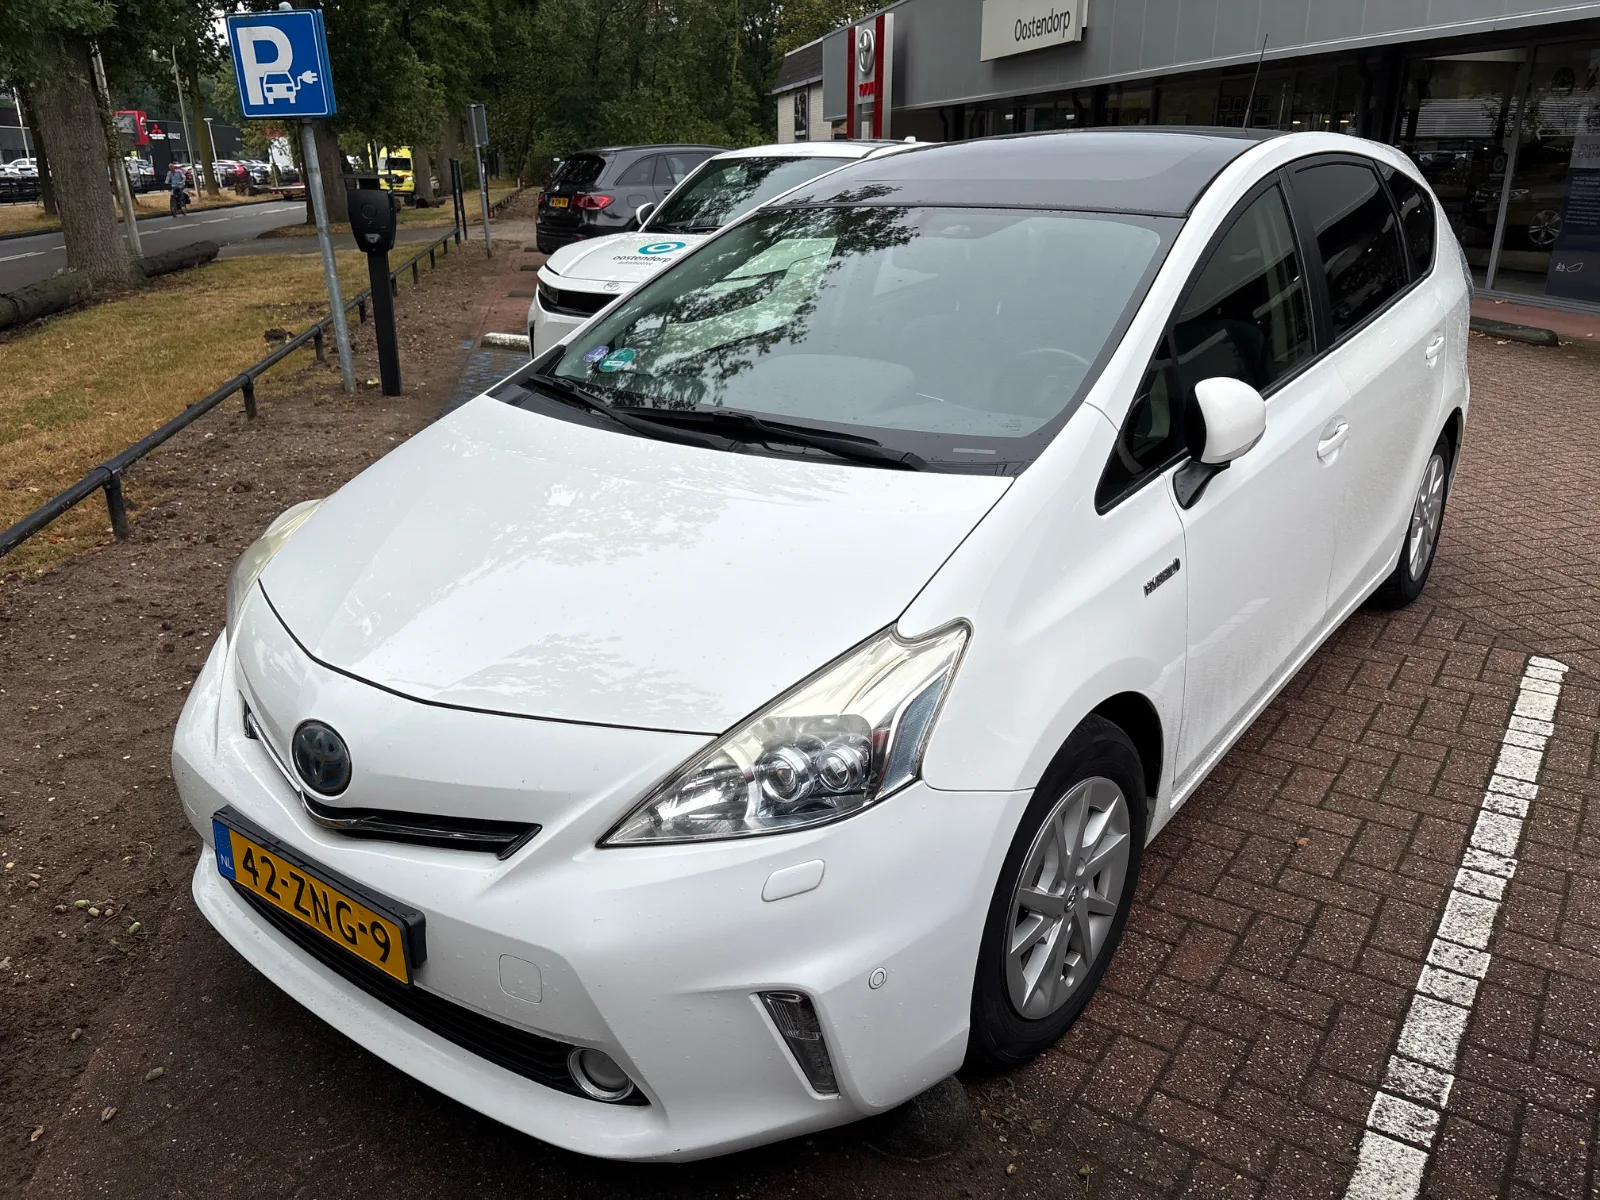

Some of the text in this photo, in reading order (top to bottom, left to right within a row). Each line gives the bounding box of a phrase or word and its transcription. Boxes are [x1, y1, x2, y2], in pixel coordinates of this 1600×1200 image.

[1014, 9, 1071, 42] Oostendorp
[236, 26, 293, 105] P
[612, 256, 672, 264] oostendorp
[220, 853, 233, 871] NL
[241, 845, 392, 965] 42-ZNG-9
